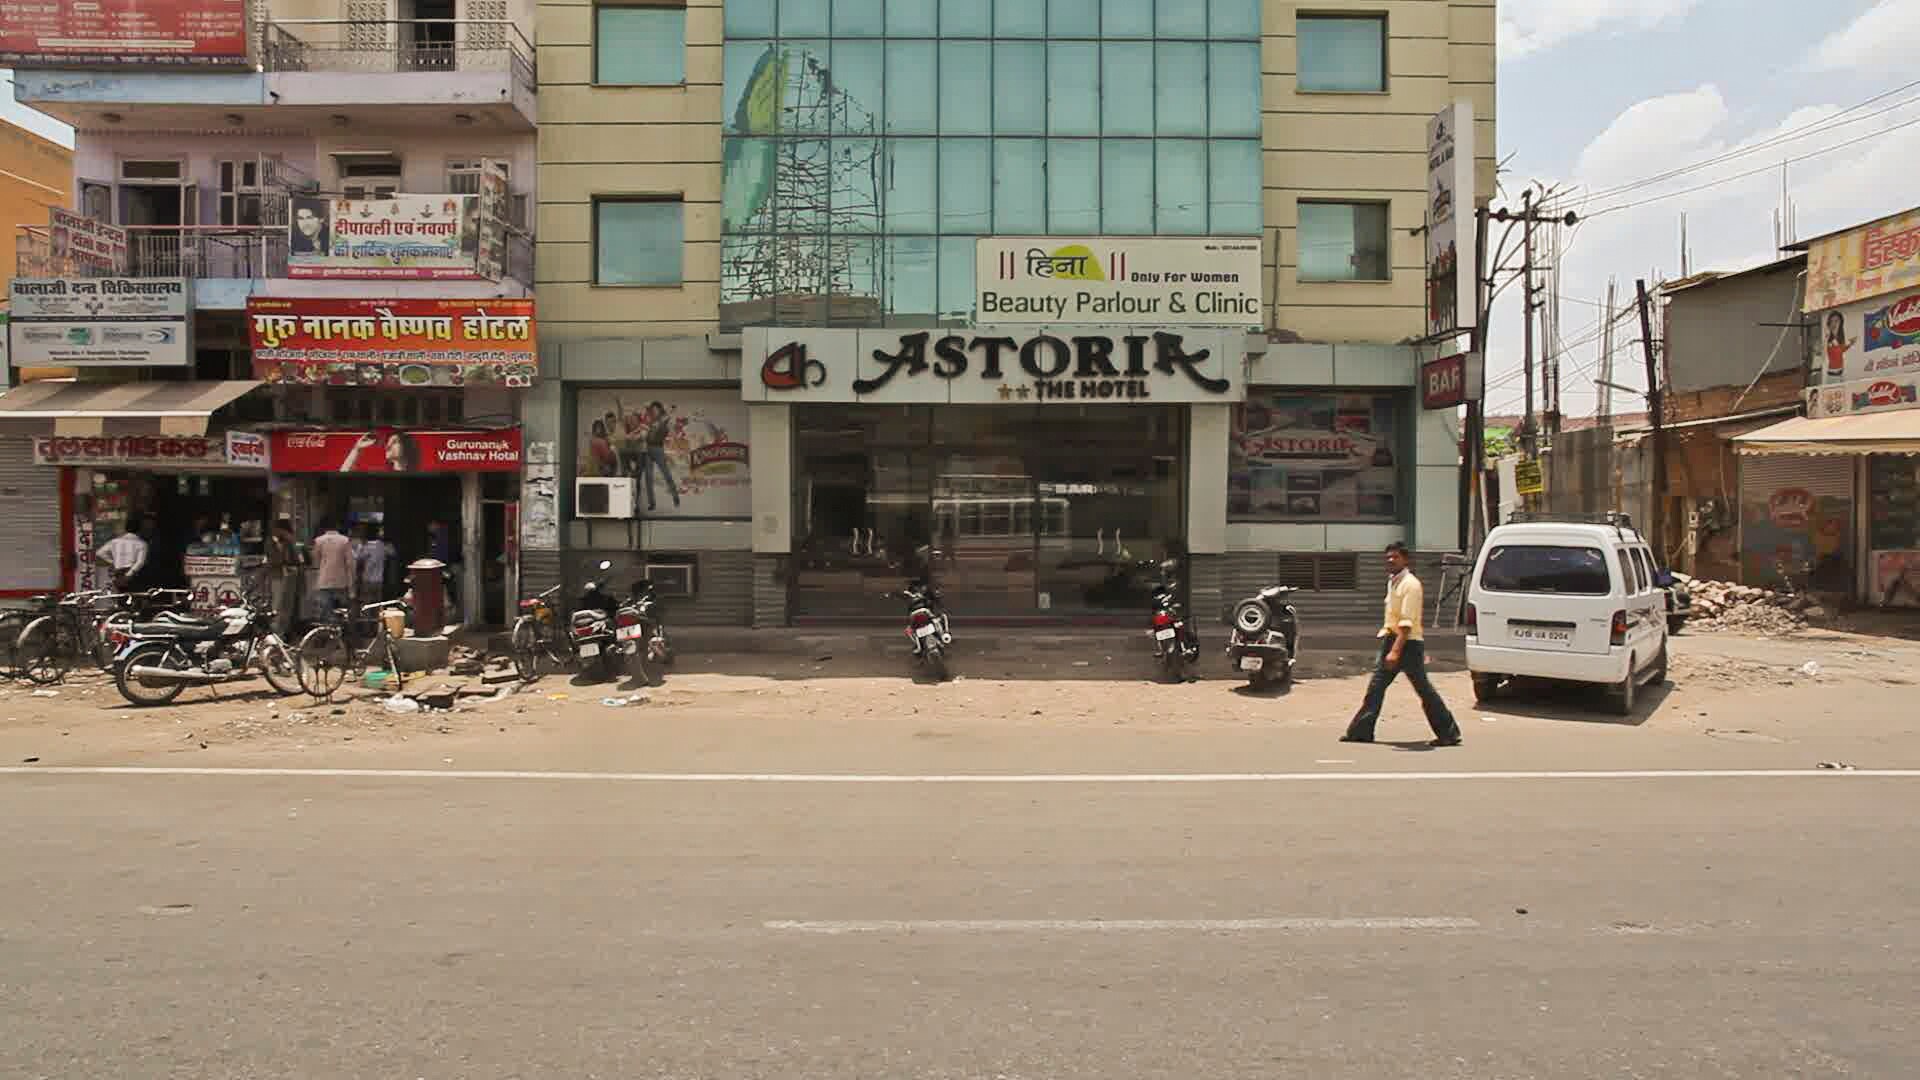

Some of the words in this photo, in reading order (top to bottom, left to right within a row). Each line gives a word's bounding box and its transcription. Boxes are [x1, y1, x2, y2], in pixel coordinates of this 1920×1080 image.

[335, 218, 391, 236] दीपावली
[394, 217, 416, 236] एवं
[417, 218, 457, 237] नववर्ष
[1024, 247, 1089, 279] हिना
[14, 280, 66, 295] बालाजी
[101, 280, 182, 296] चिकित्सालय
[1131, 272, 1160, 284] Only
[1164, 272, 1187, 283] For
[1191, 272, 1239, 284] Women
[982, 291, 1067, 320] Beauty
[1076, 291, 1161, 314] Parlour
[1168, 291, 1186, 314] &
[1195, 291, 1259, 314] Clinic
[252, 314, 298, 347] गुरु
[300, 314, 377, 340] नानक
[375, 307, 453, 341] वैष्णव
[461, 307, 531, 340] होटल
[852, 330, 1231, 395] ASTORIA
[1035, 380, 1076, 399] THE
[1079, 380, 1151, 399] HOTEL
[1429, 366, 1461, 395] BAR
